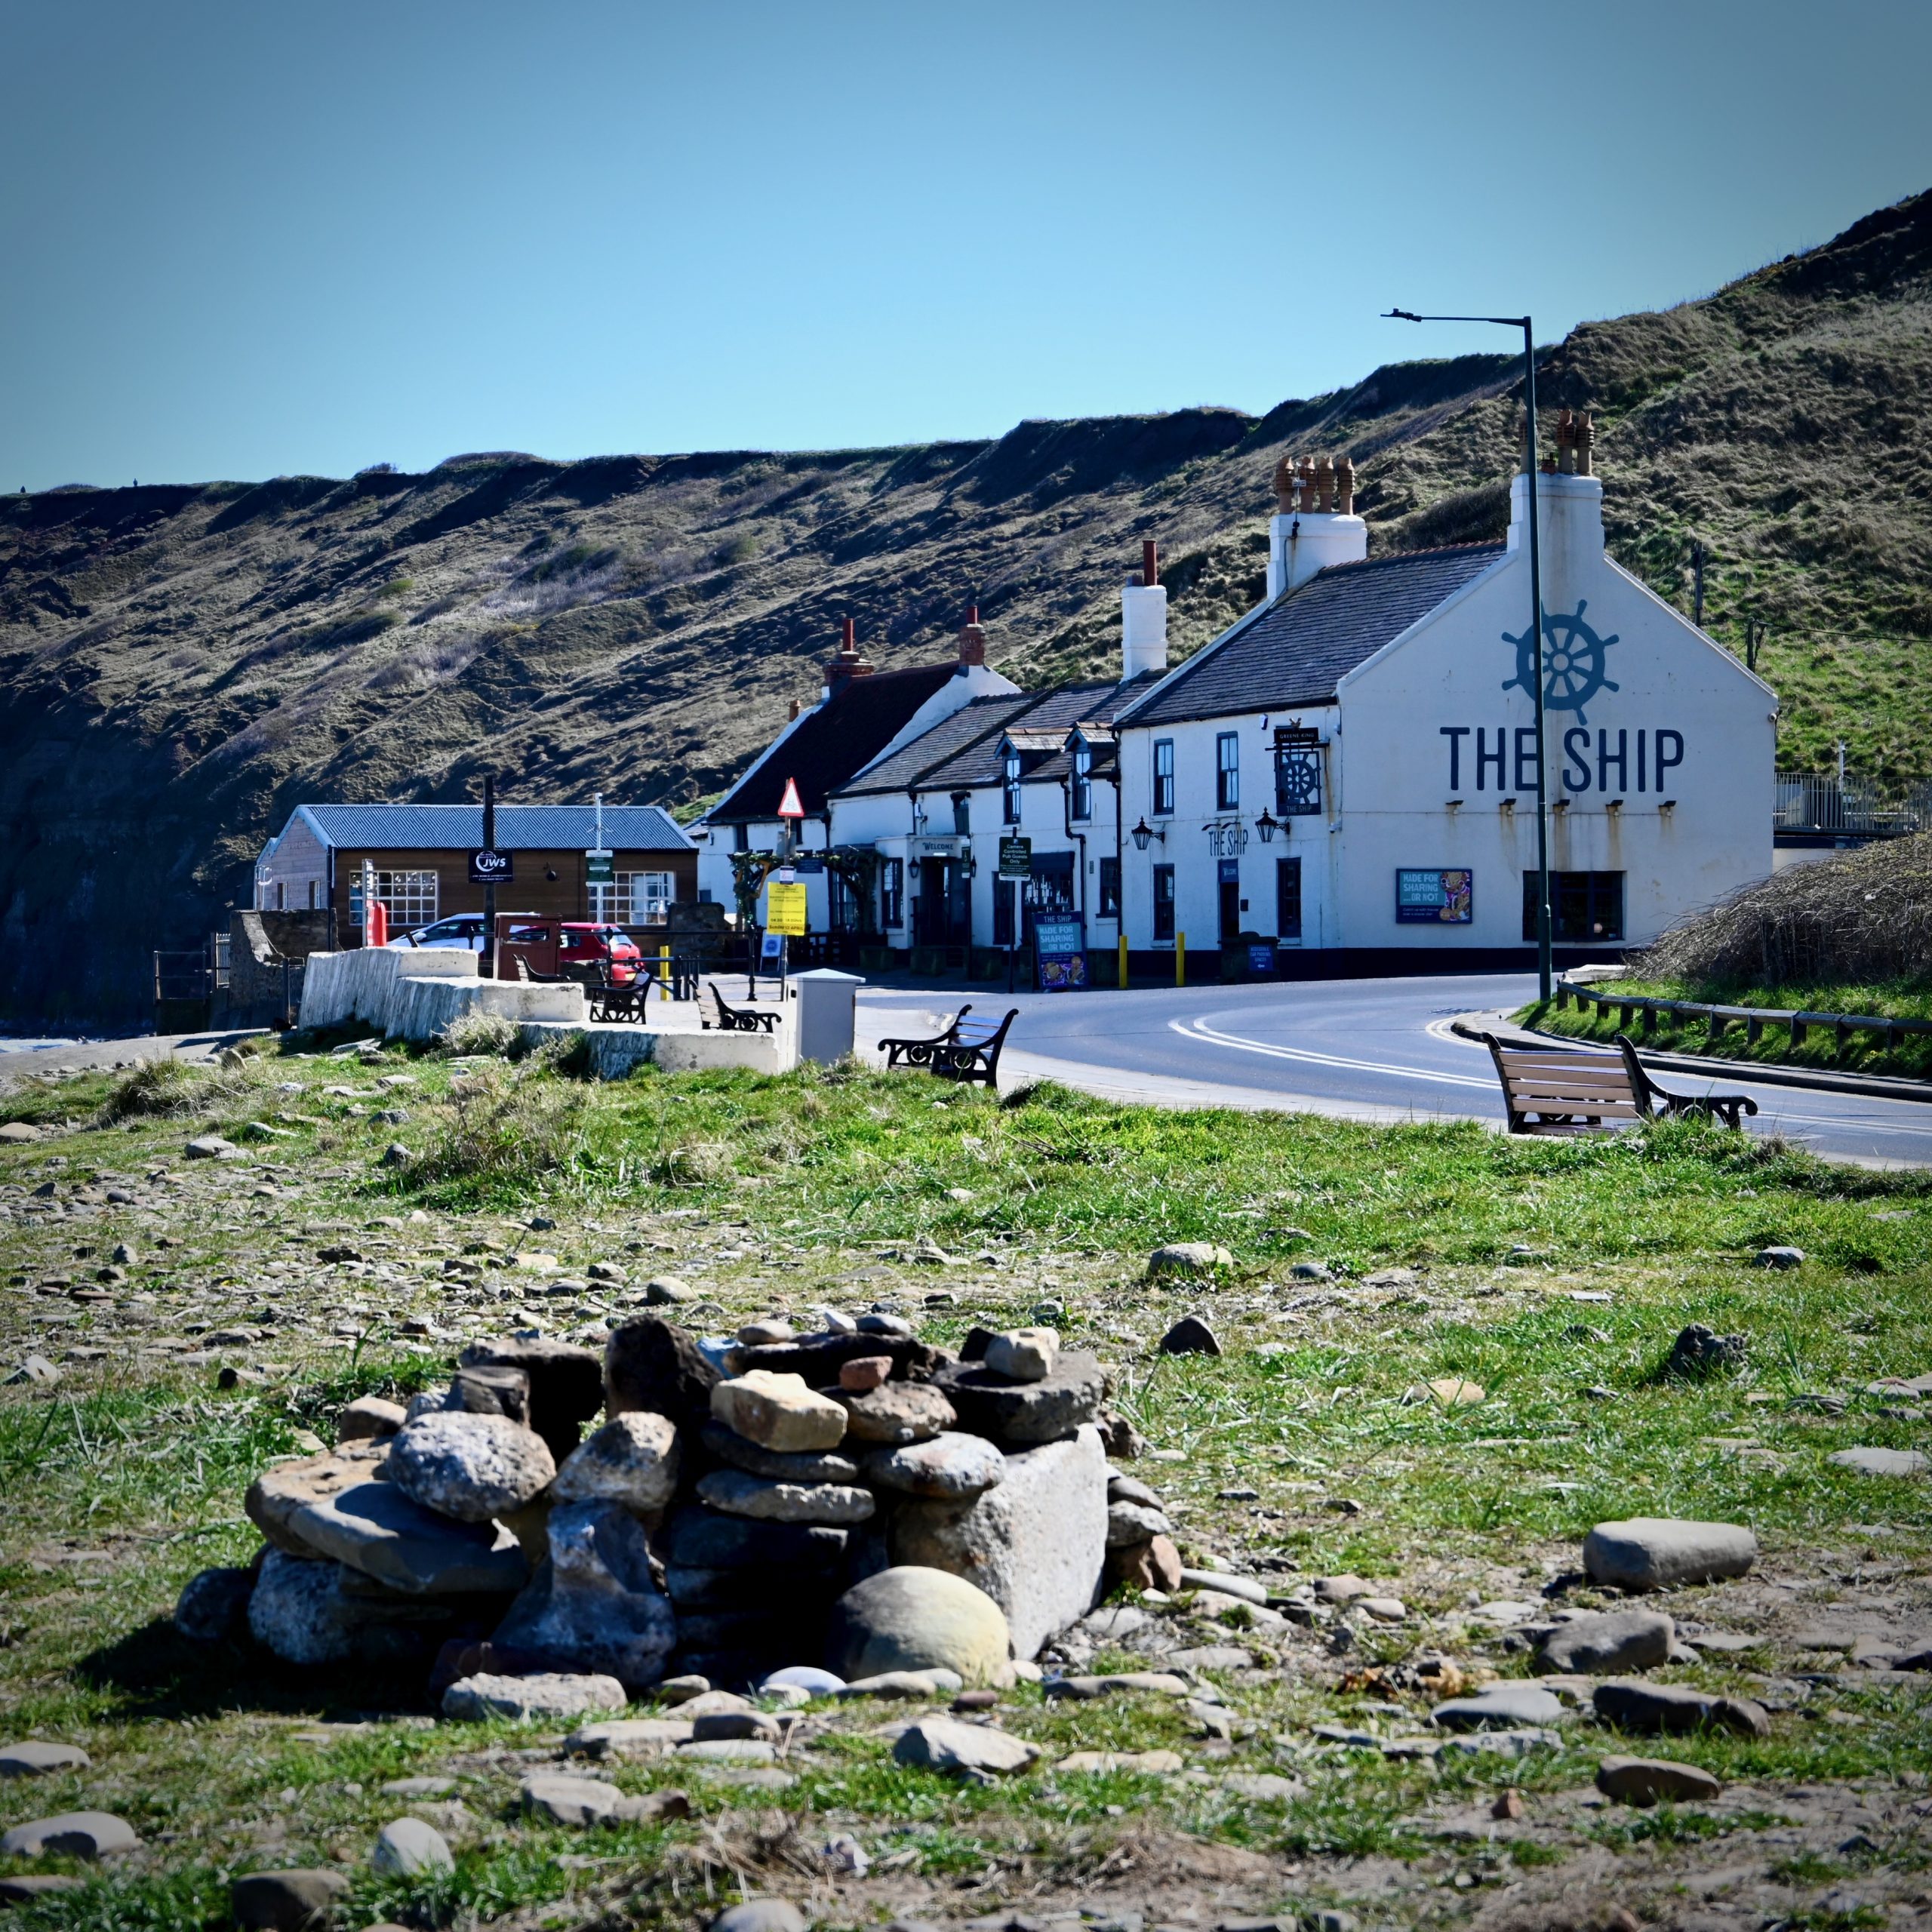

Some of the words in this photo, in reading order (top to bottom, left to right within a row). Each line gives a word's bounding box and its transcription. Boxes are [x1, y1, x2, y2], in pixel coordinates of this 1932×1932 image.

[1439, 727, 1540, 792] THE
[1562, 727, 1684, 792] SHIP
[922, 841, 954, 851] WELCOME
[1208, 830, 1226, 857] THE
[1227, 829, 1248, 856] SHIP
[483, 857, 506, 867] JWS
[1403, 873, 1422, 882] MADE
[1423, 873, 1438, 882] FOR
[1403, 883, 1438, 892] SHARING
[1423, 893, 1438, 901] NOT
[1039, 926, 1058, 934] MADE
[1059, 925, 1073, 934] FOR
[1040, 934, 1074, 943] SHARING
